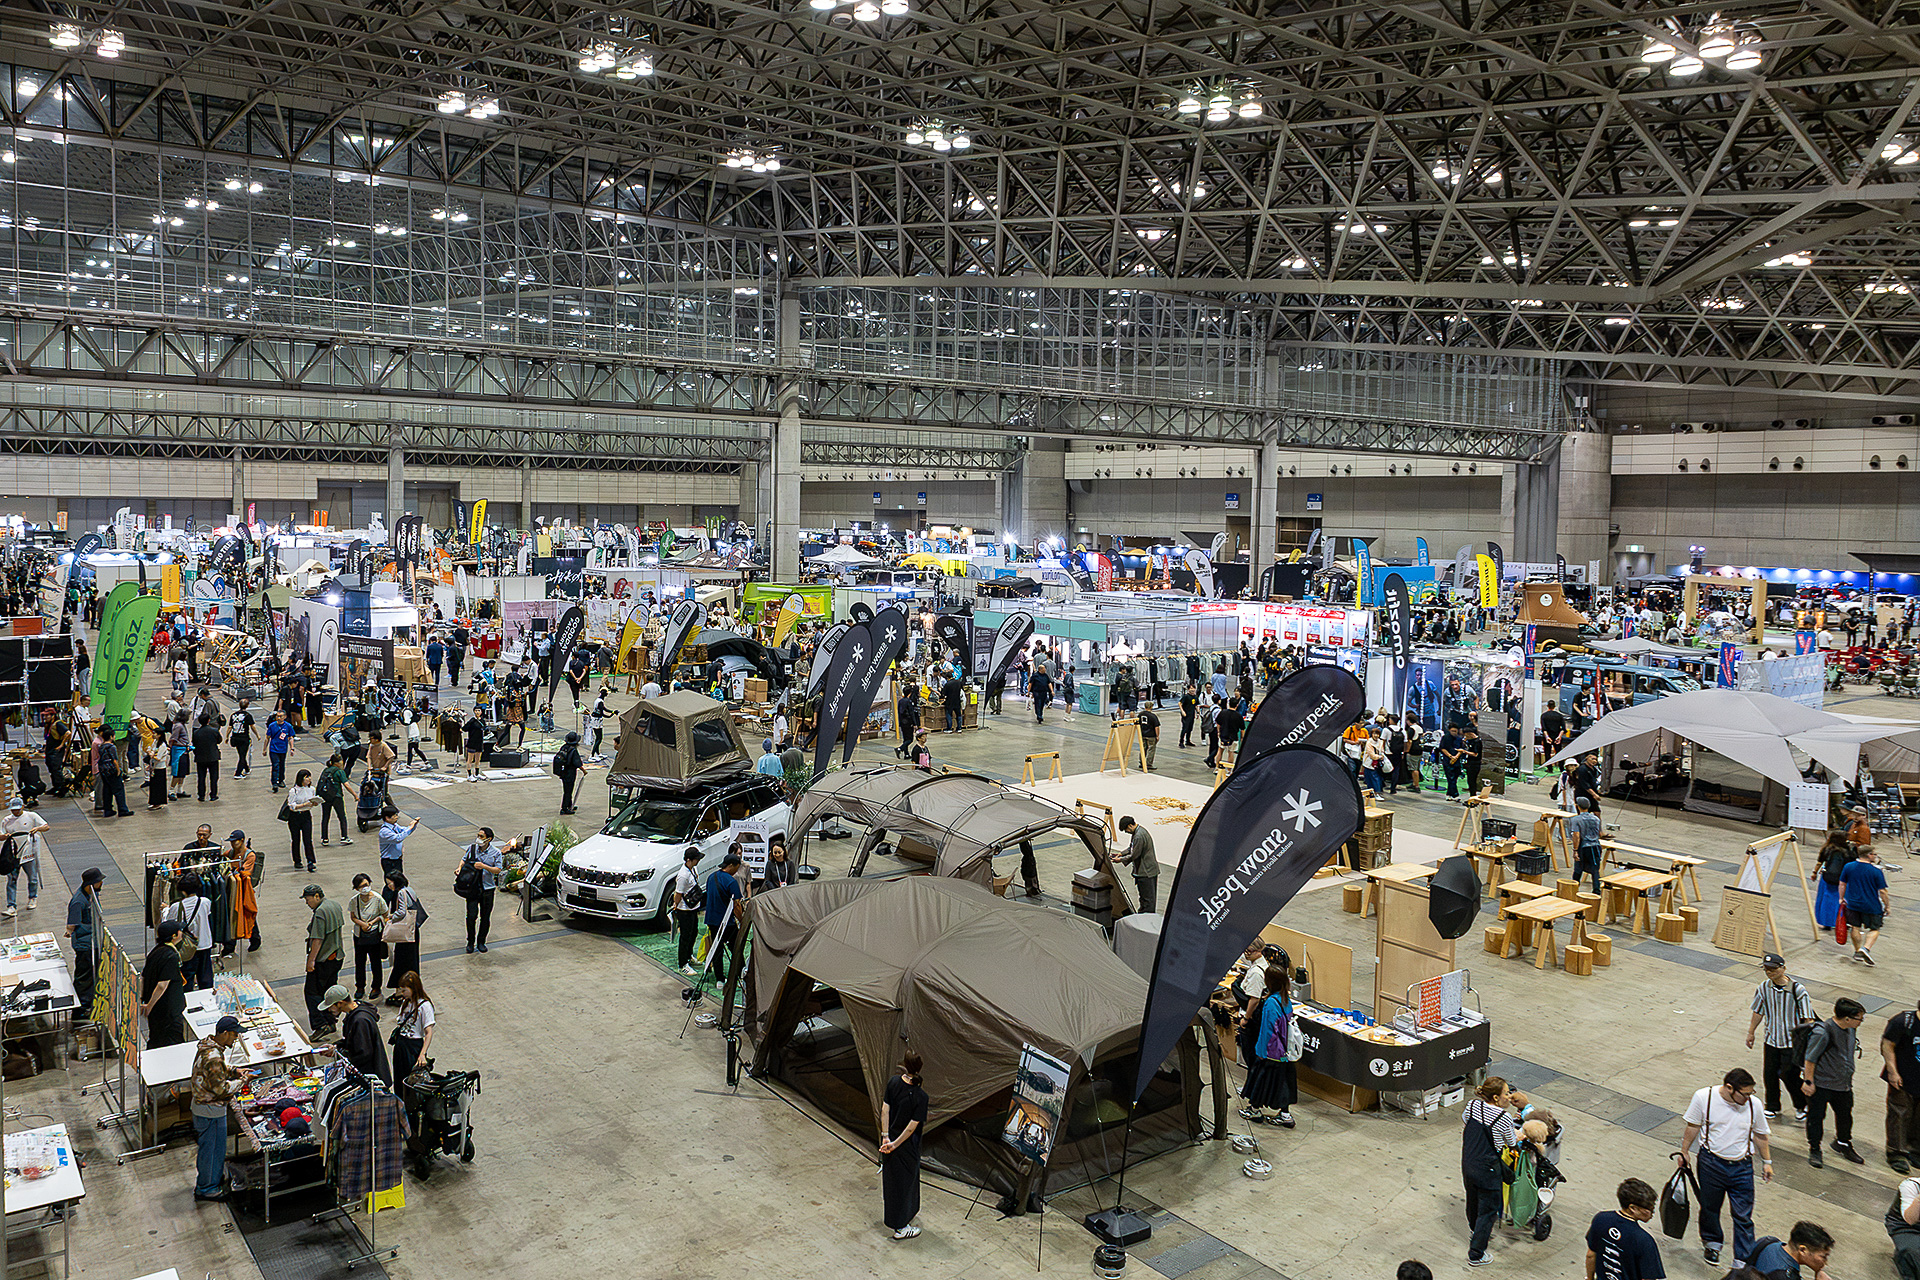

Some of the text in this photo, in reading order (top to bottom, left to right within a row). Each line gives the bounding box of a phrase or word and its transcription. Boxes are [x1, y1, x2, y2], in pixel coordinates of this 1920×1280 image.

[83, 538, 99, 556] TREK
[213, 539, 237, 567] PRO TREK
[559, 618, 576, 650] FACTORY
[366, 645, 383, 657] COFFEE
[1300, 692, 1340, 730] peak
[1392, 1059, 1414, 1071] 会計
